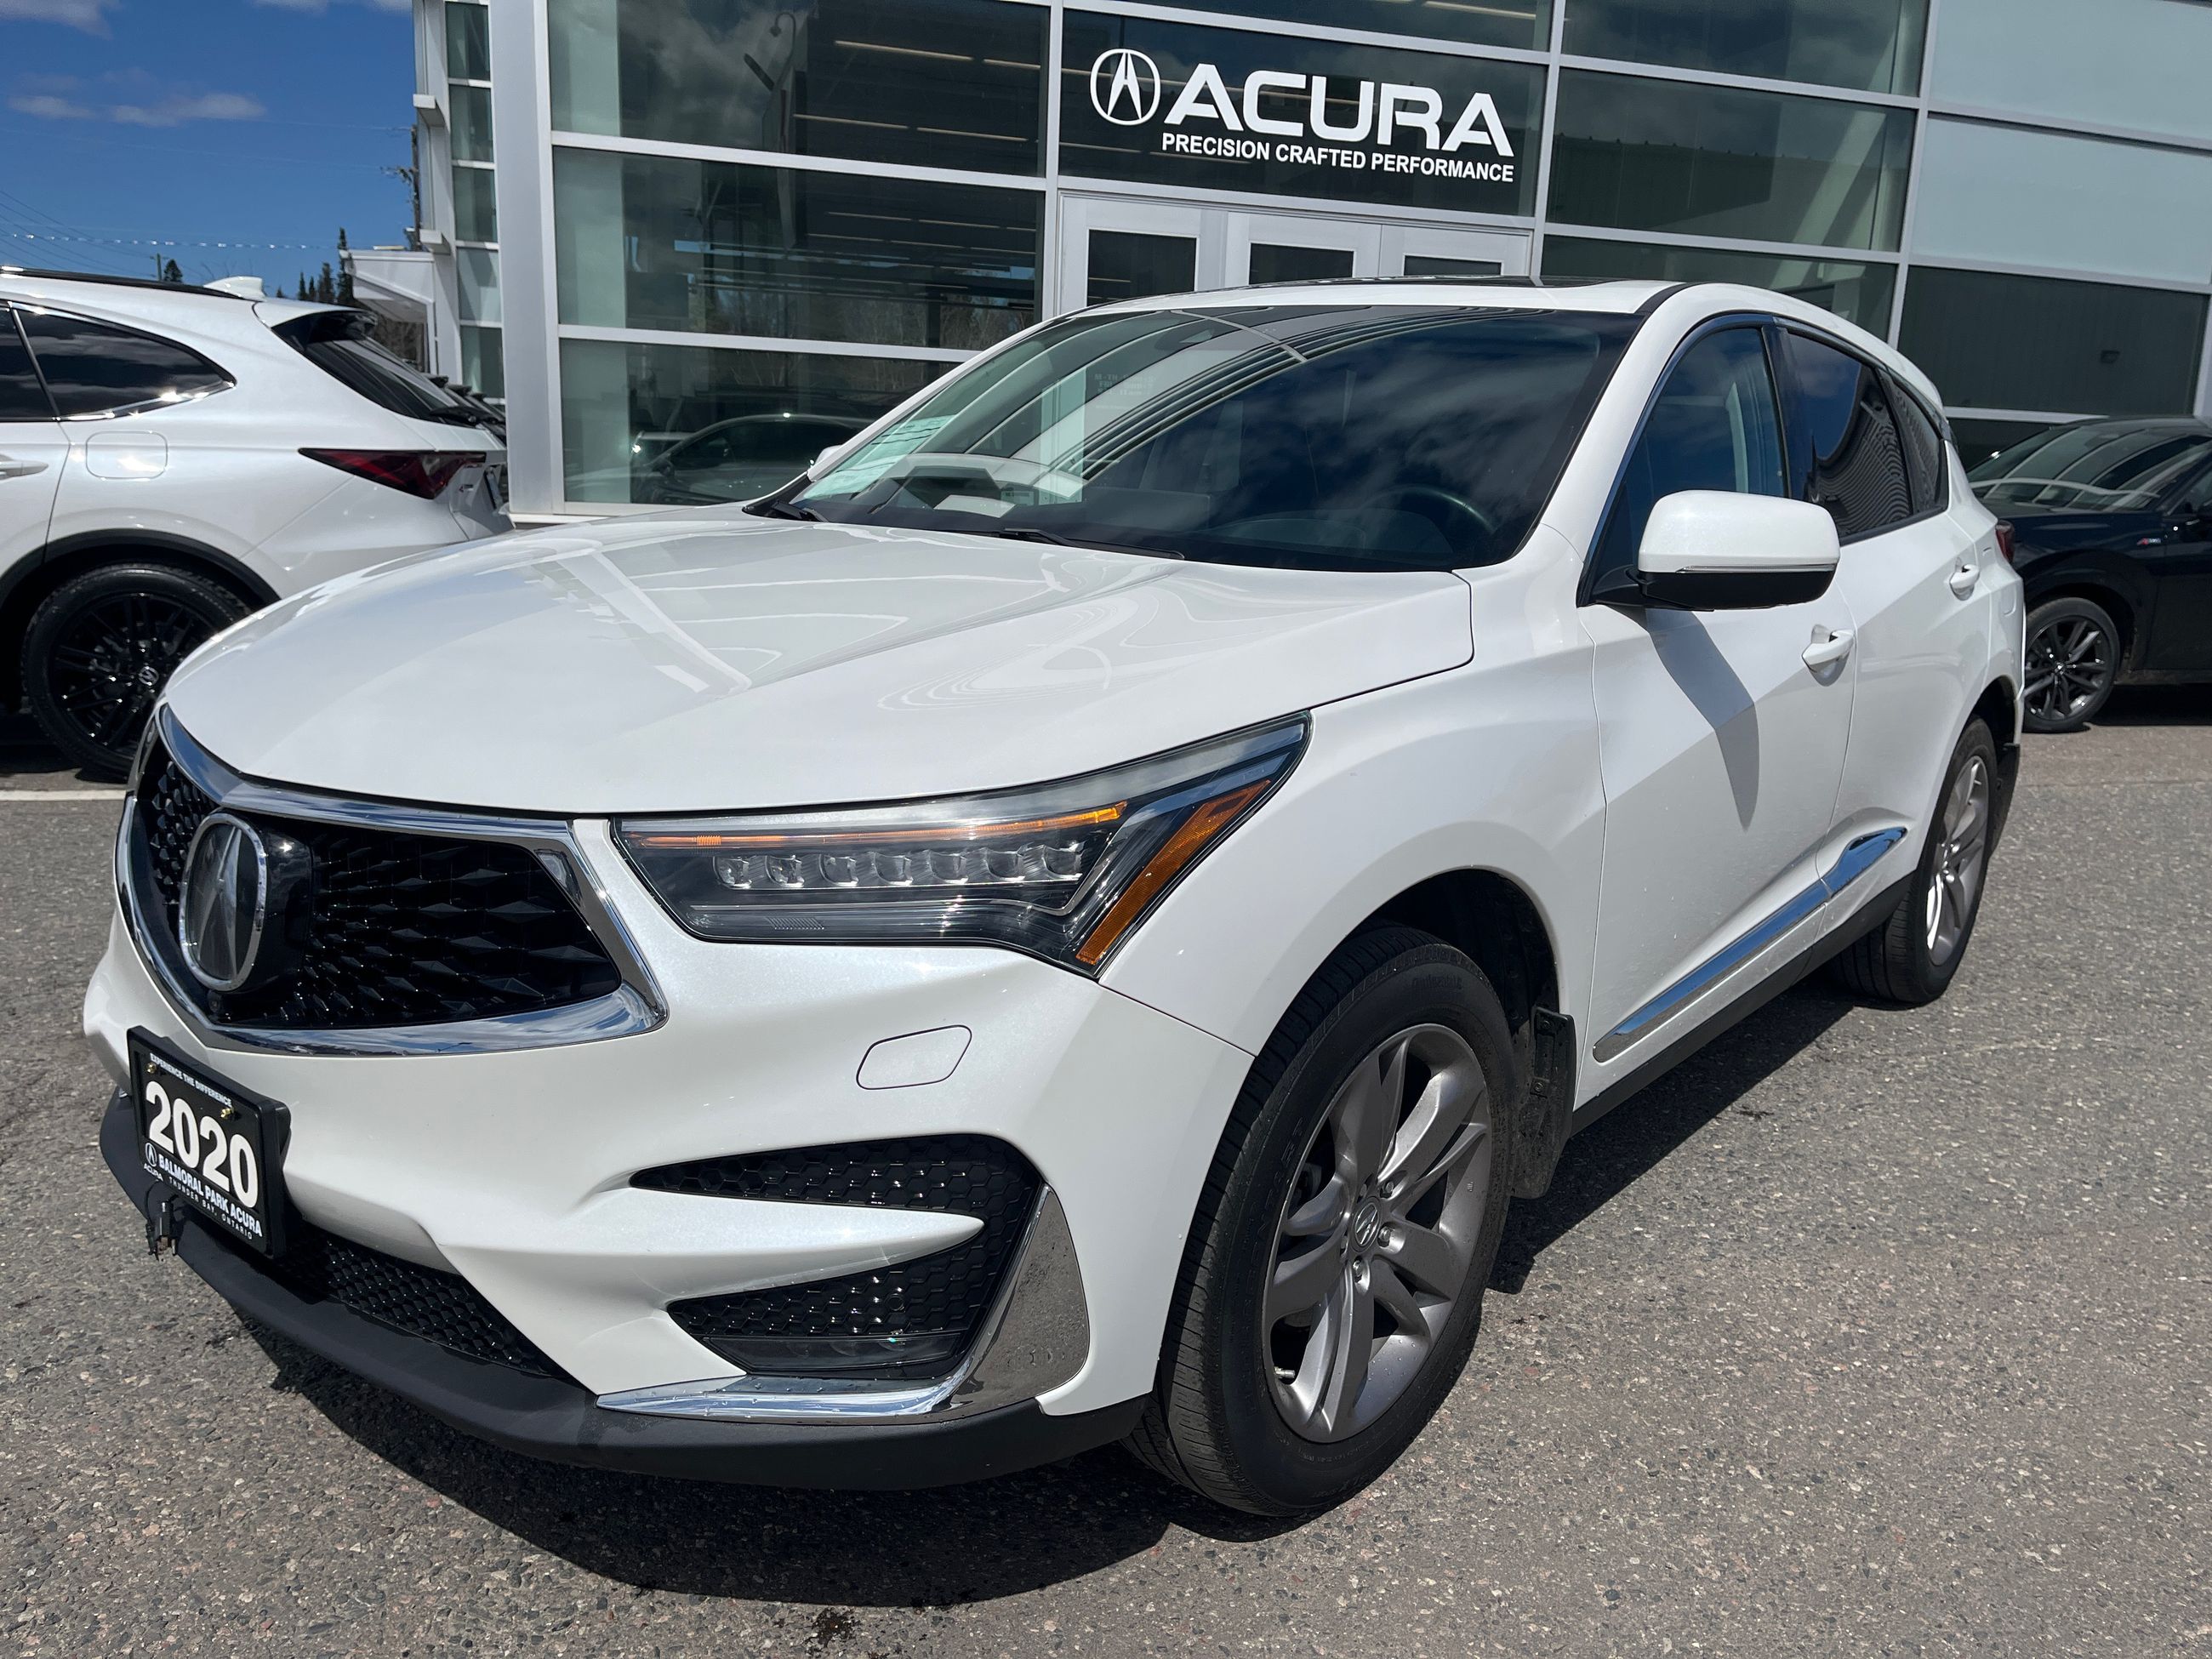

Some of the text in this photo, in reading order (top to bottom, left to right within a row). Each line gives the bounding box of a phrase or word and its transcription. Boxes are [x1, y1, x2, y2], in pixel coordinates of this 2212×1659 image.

[1164, 63, 1514, 157] ACURA
[1162, 133, 1514, 183] PRECISION CRAFTED PERFORMANCE
[150, 1052, 233, 1108] EXPERIENCE THE DIFFERENCE
[145, 1080, 259, 1208] 2020
[158, 1154, 263, 1237] BALMORAL PARK ACURA
[169, 1177, 199, 1203] THUNDER
[221, 1213, 253, 1240] ONTARIO
